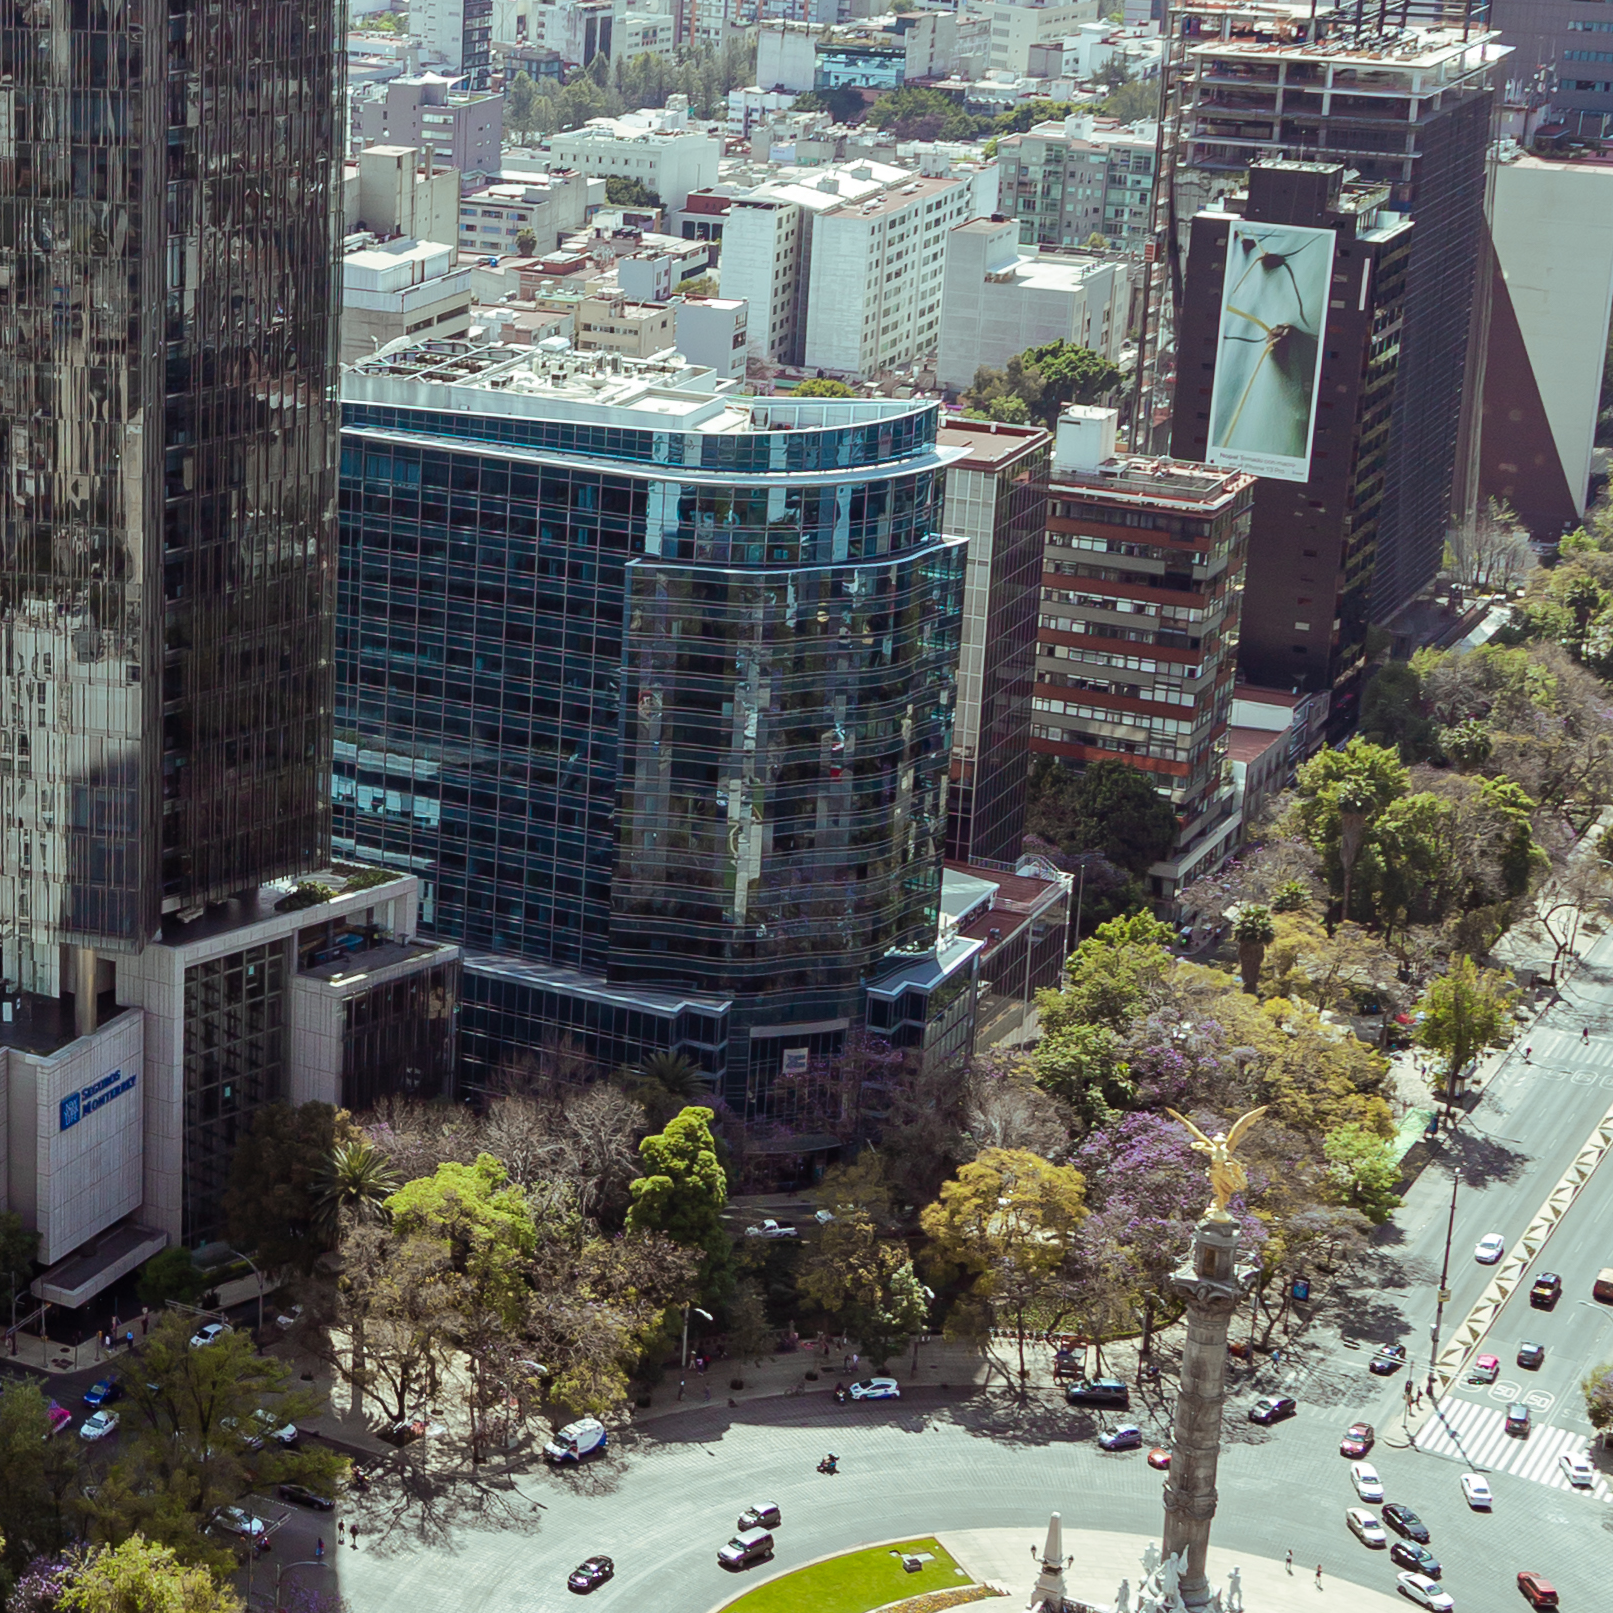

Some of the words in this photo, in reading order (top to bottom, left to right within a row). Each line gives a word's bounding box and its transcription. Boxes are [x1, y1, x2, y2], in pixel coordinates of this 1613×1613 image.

[1244, 463, 1264, 472] iPhone
[1493, 1384, 1516, 1398] 50
[1526, 1394, 1551, 1408] 50
